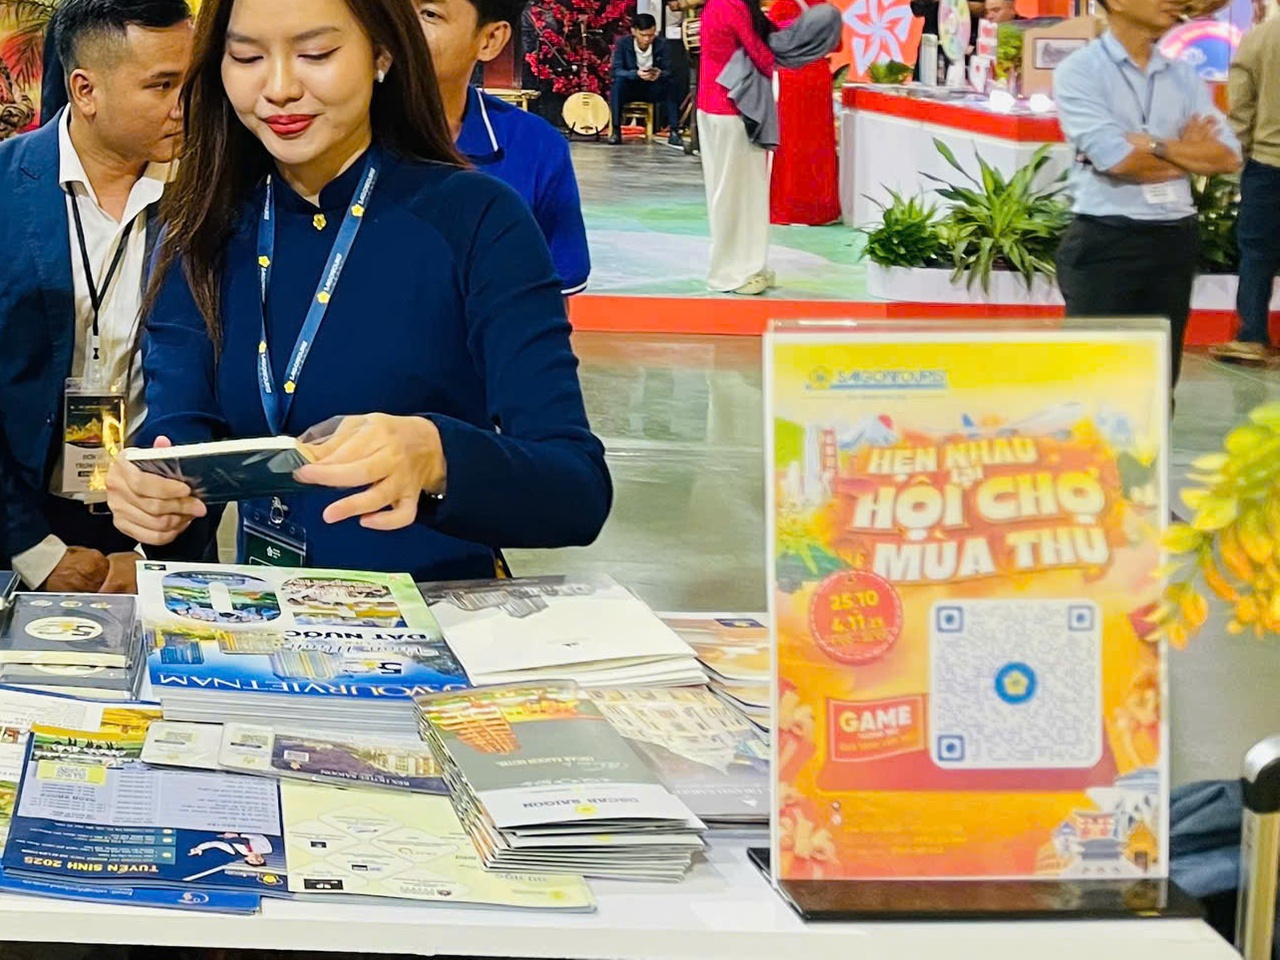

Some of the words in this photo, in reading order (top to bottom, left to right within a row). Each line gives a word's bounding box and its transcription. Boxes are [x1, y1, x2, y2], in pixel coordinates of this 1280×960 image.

[867, 447, 937, 482] HẸN
[944, 437, 1037, 469] NHAU
[852, 475, 965, 540] HỘI
[976, 466, 1106, 524] CHỢ
[873, 528, 996, 581] MÙA
[1005, 526, 1110, 569] THU
[839, 705, 912, 733] GAME
[66, 861, 103, 873] SINH
